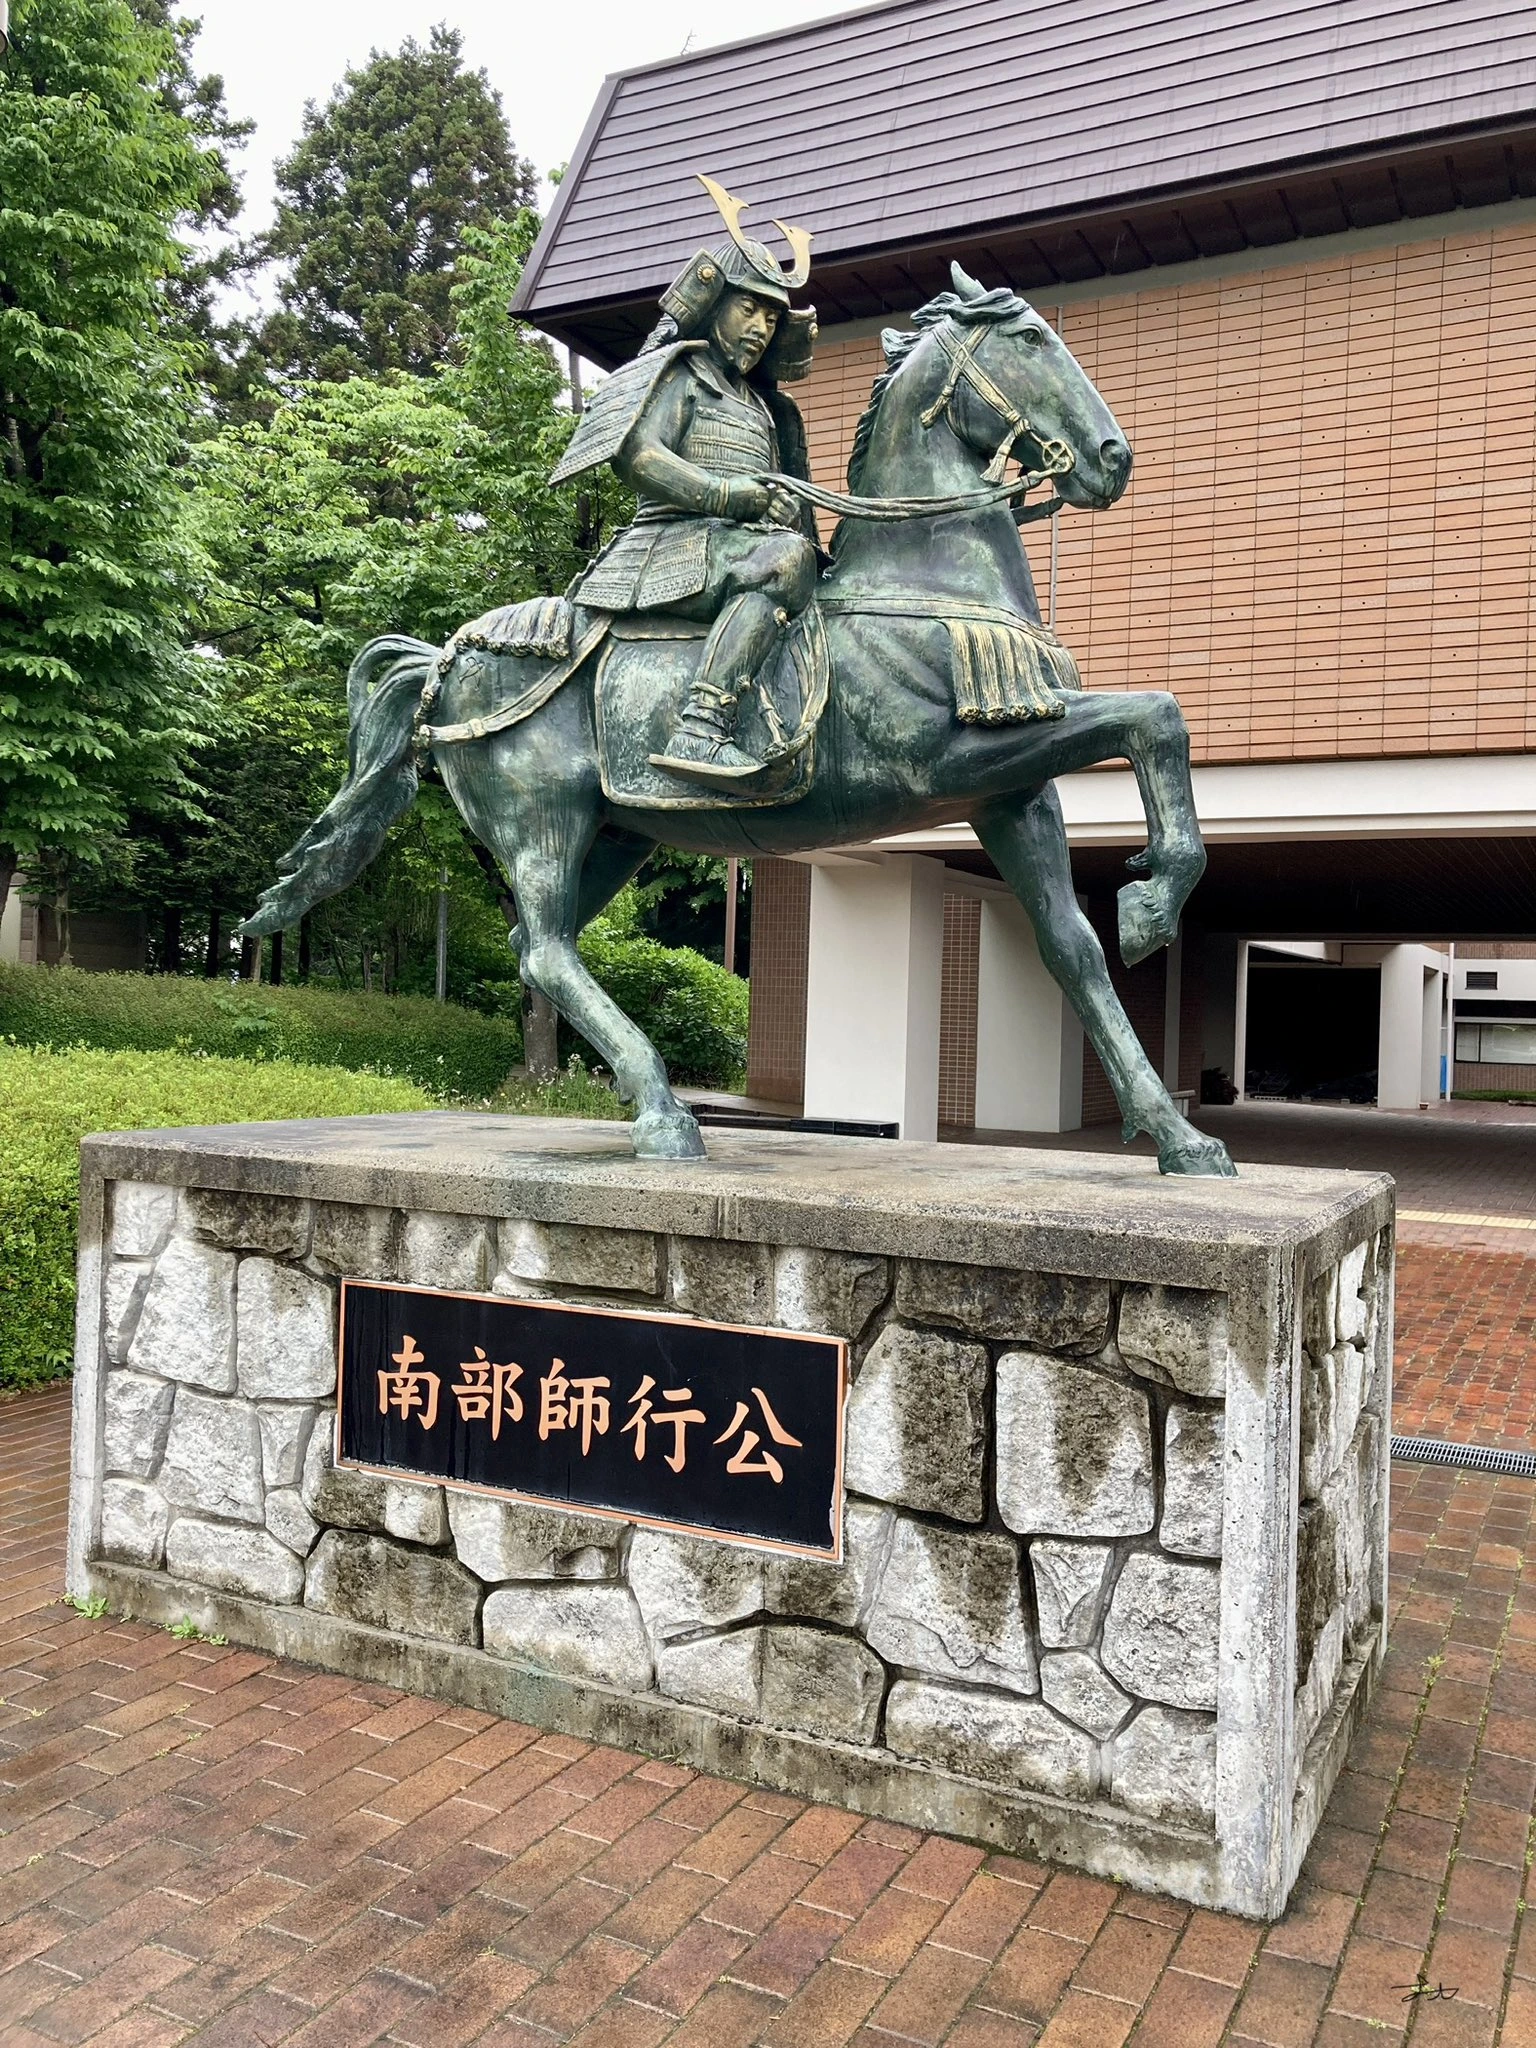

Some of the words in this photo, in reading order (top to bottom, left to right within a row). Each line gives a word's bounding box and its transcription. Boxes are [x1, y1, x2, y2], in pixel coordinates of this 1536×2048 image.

[376, 1335, 803, 1483] 南部師行公
